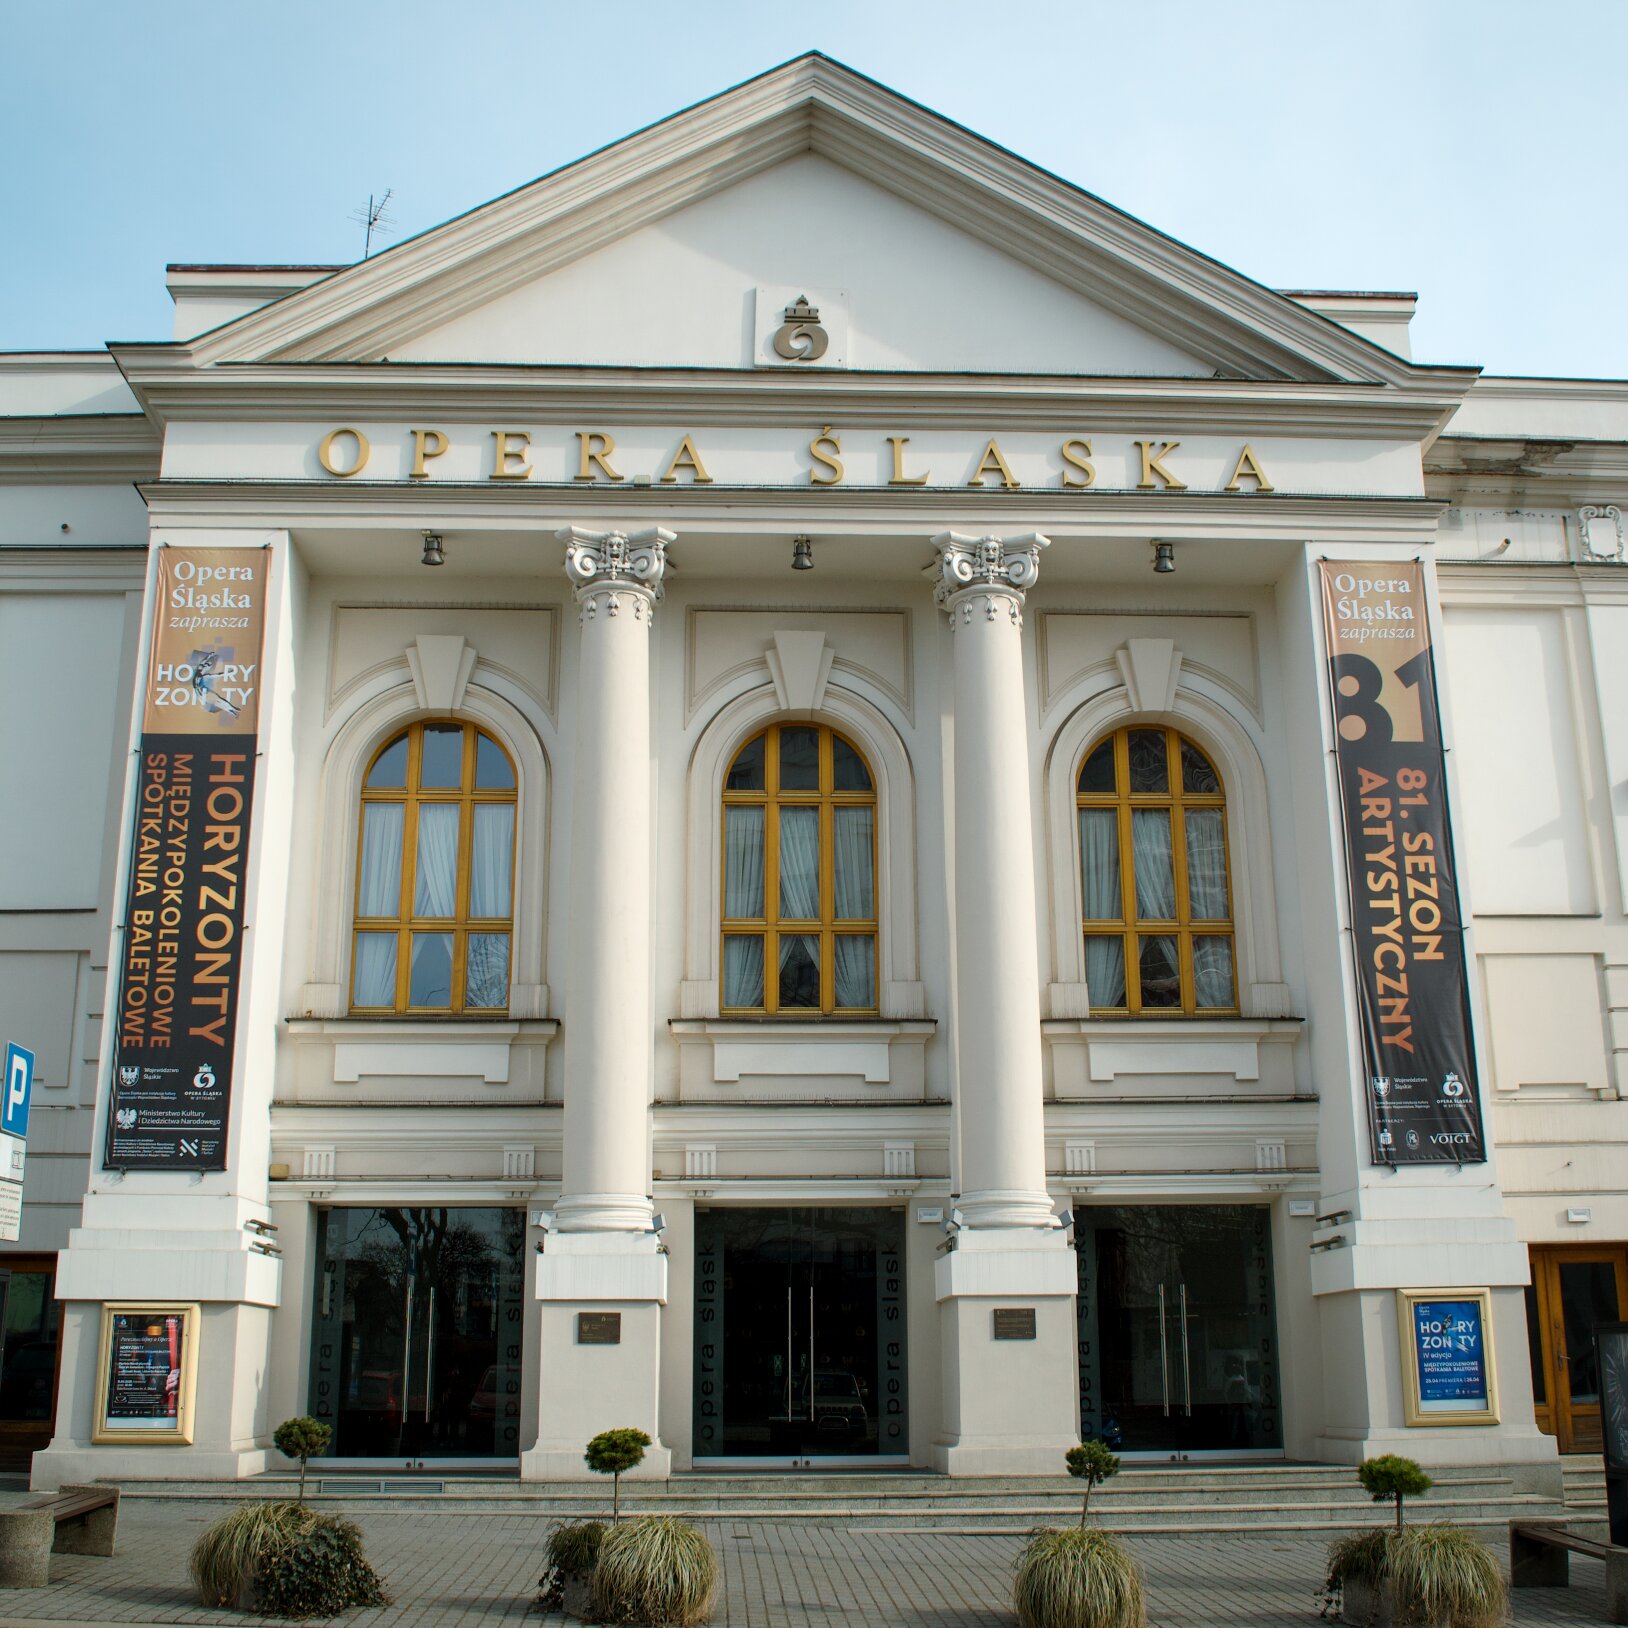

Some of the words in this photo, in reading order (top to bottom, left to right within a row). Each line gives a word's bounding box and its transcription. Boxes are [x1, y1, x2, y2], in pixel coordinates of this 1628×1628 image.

[318, 427, 713, 483] OPERA
[810, 424, 1275, 491] ŚLĄSKA
[171, 584, 252, 613] Śląska
[174, 561, 254, 586] Opera
[1335, 574, 1411, 598] Opera
[169, 615, 249, 632] zaprasza
[1337, 597, 1415, 625] Śląska
[1340, 627, 1415, 643] zaprasza
[1396, 767, 1429, 819] 81.
[135, 753, 168, 897] SPOTKANIA
[150, 754, 194, 1048] MIĘDZYPOKOLENIOWE
[188, 754, 247, 1047] HORYZONTY
[1356, 767, 1415, 1054] ARTYSTYCZNY
[1402, 832, 1444, 960] SEZON
[122, 910, 155, 1048] BALETOWE
[182, 1110, 205, 1118] Kultury
[1430, 1134, 1471, 1144] VOIGT
[700, 1344, 717, 1441] opera
[887, 1342, 903, 1438] opera
